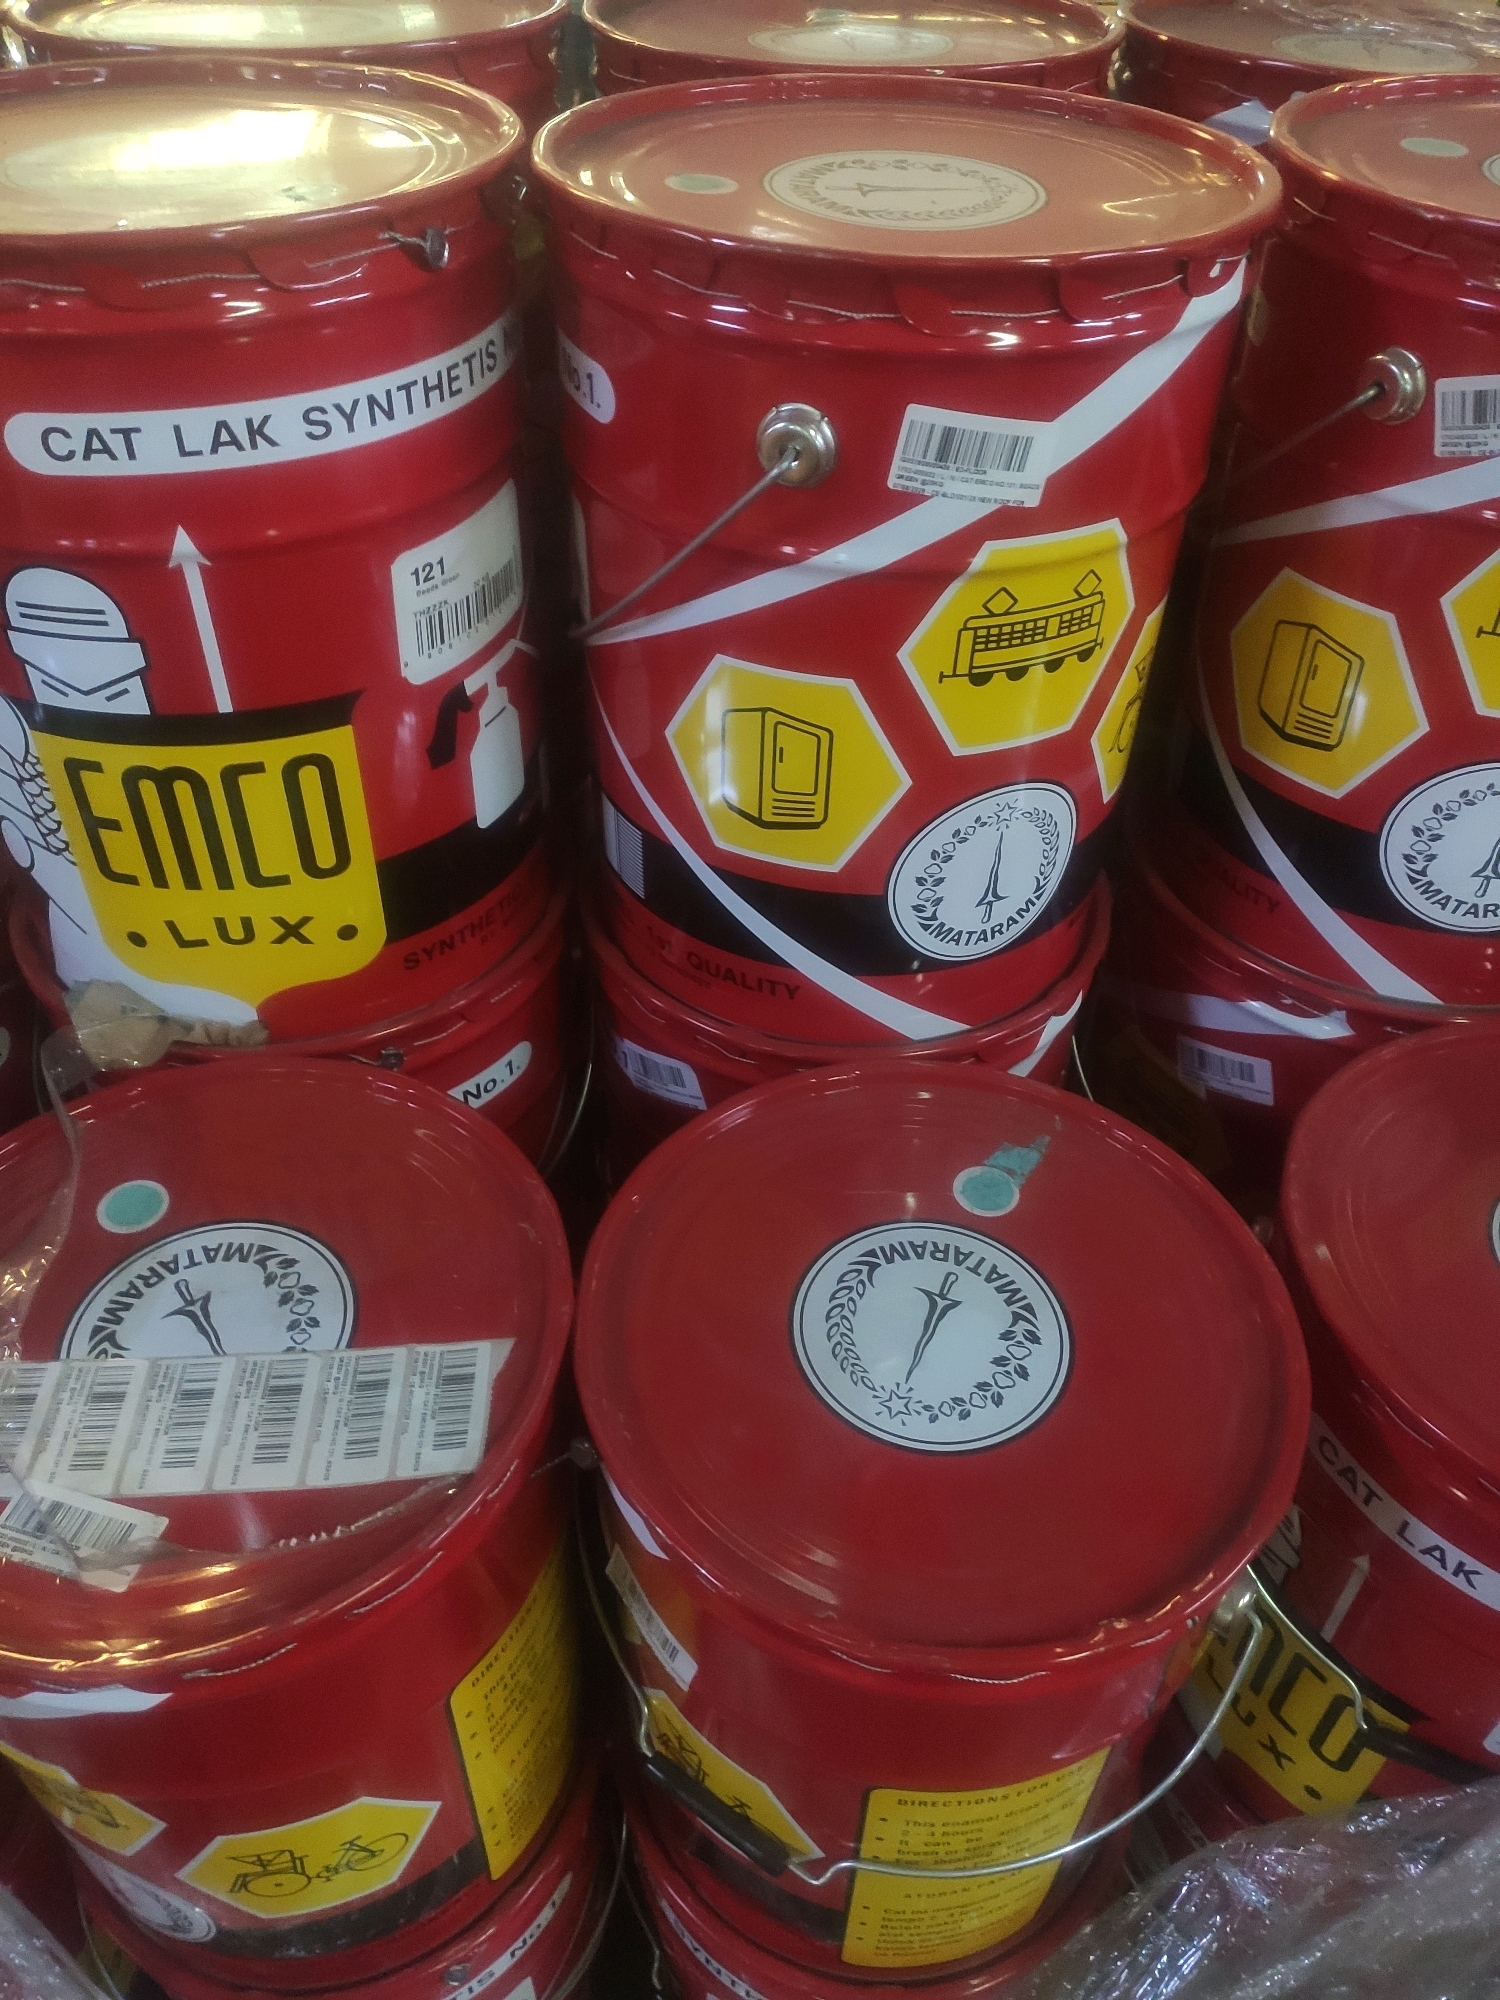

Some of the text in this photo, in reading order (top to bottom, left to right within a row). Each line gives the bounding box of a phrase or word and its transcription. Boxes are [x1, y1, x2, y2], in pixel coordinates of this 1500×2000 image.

[41, 426, 141, 462] CAT
[173, 414, 280, 458] LAK
[302, 338, 499, 441] SYNTHETIS
[411, 557, 445, 586] 121
[63, 752, 352, 891] EMCO
[163, 915, 316, 949] LUX
[928, 897, 1038, 947] MATARAM
[686, 950, 801, 1001] QUALITY
[97, 1241, 256, 1327] MATARAM
[878, 1240, 1029, 1308] MATARAM
[1319, 1435, 1484, 1591] CAT LAK
[897, 1792, 1010, 1808] DIRECTIONS
[904, 1820, 936, 1828] This
